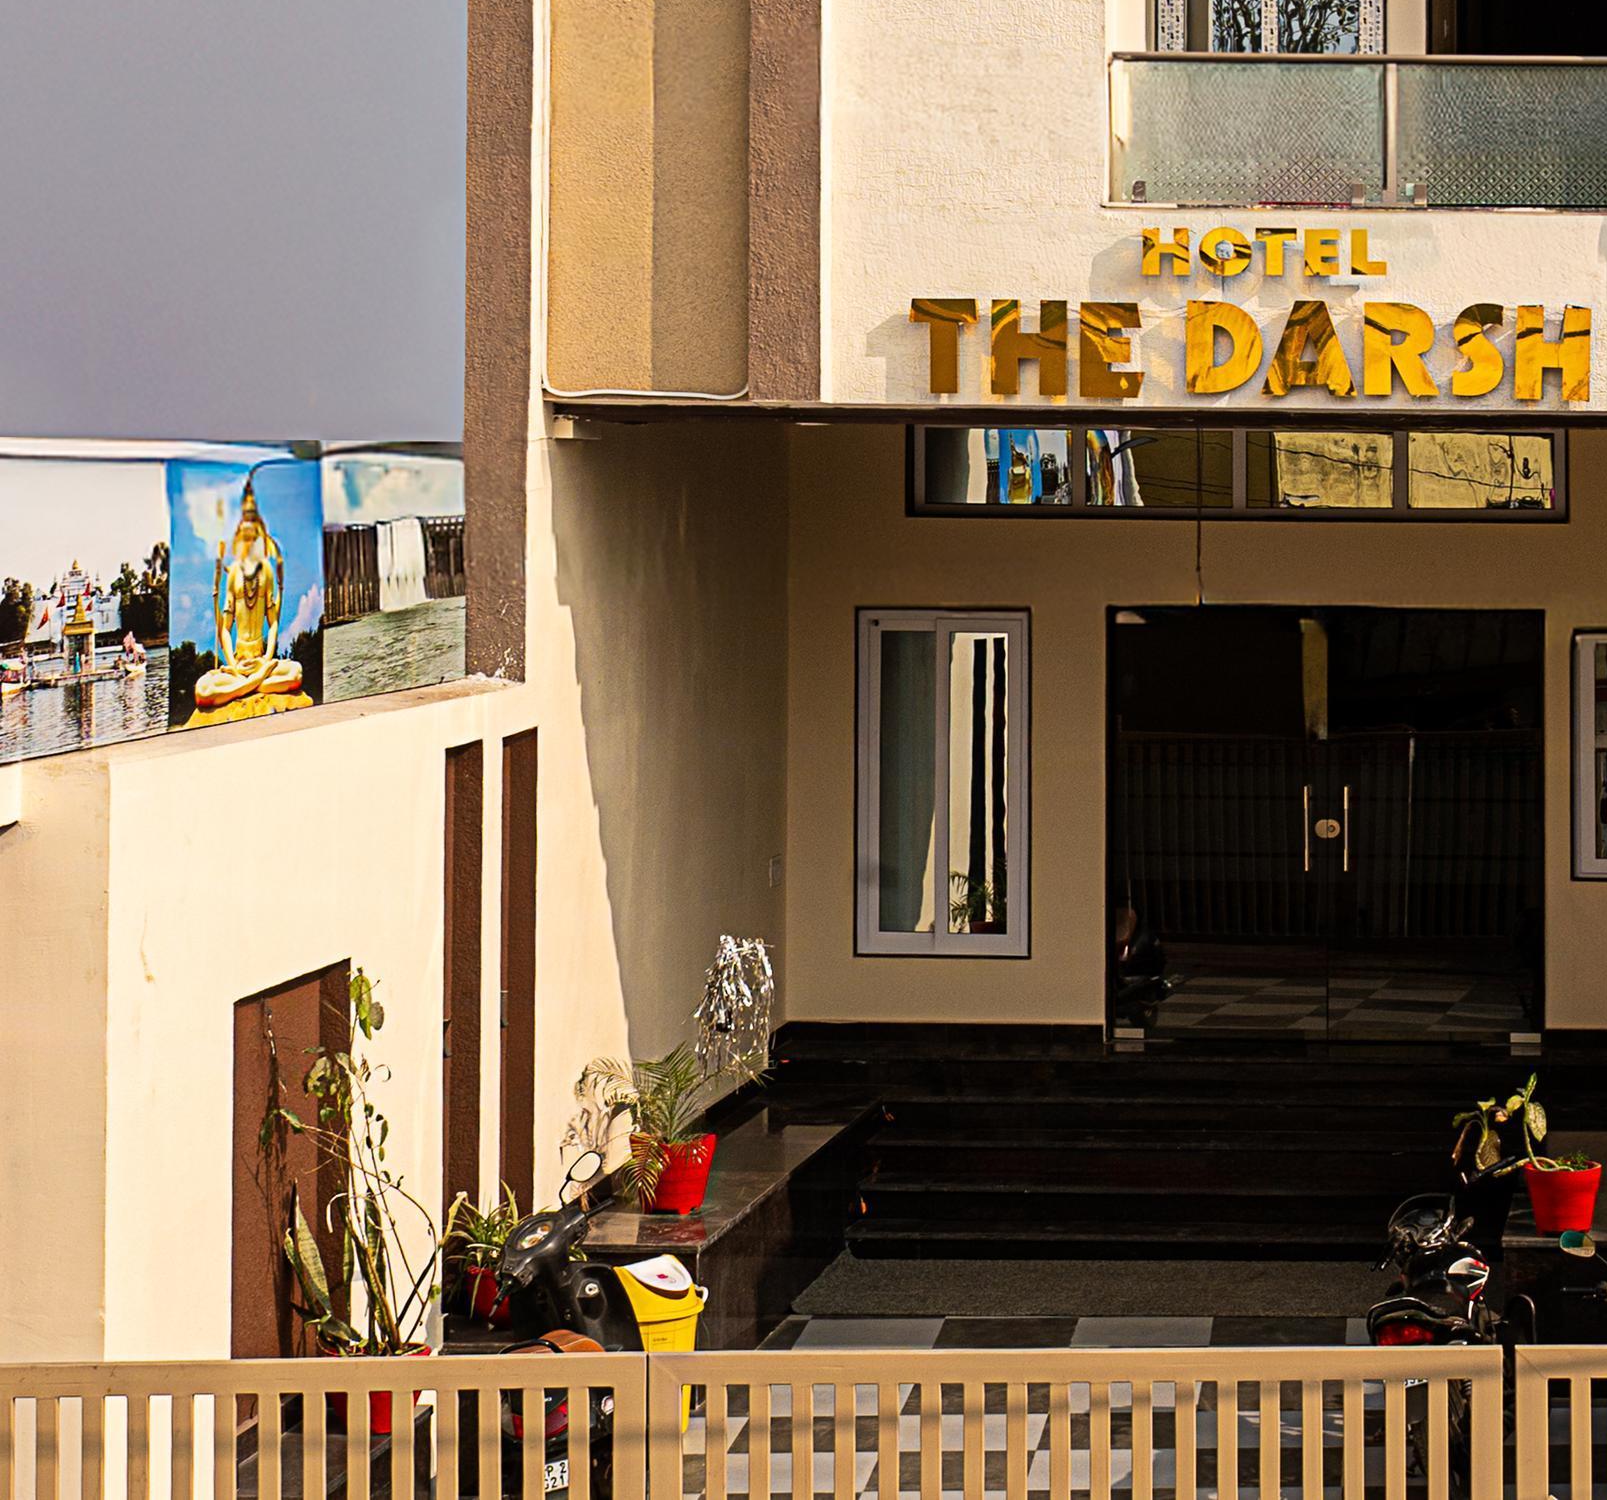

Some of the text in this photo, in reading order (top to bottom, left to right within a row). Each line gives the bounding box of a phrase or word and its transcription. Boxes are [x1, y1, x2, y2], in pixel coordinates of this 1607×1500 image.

[1141, 227, 1388, 277] HOTEL
[909, 298, 1592, 402] THE DARSH
